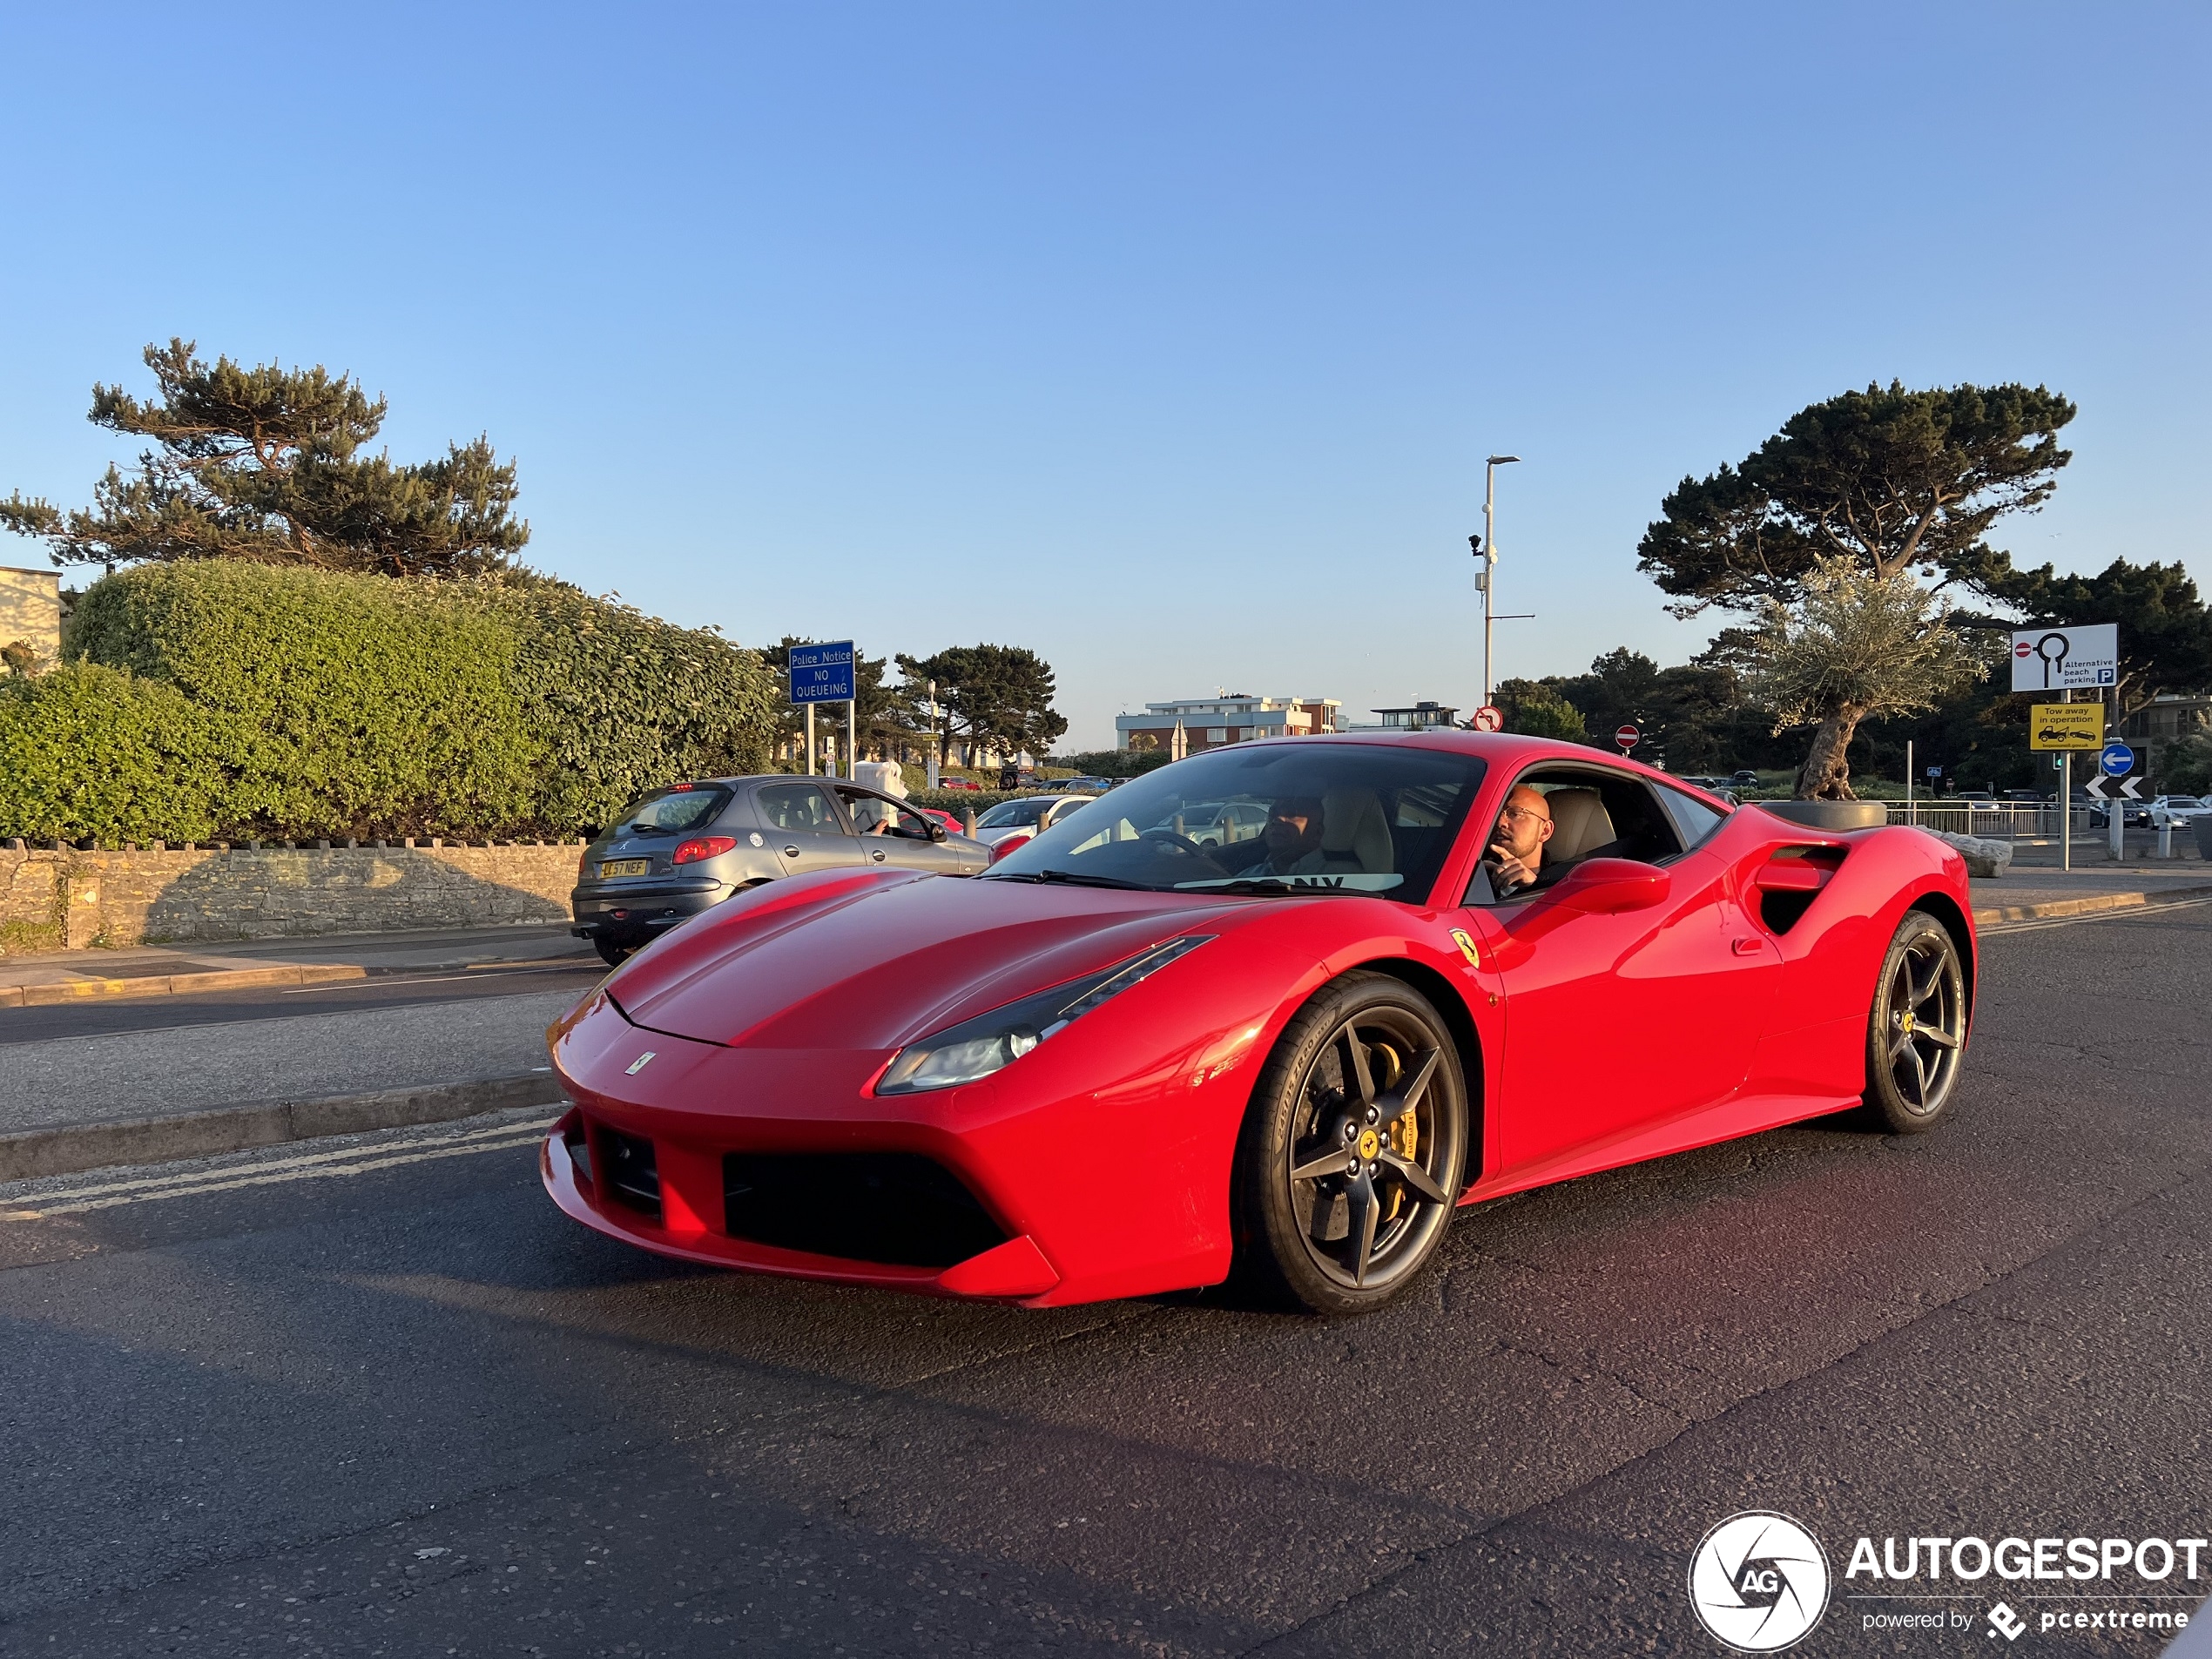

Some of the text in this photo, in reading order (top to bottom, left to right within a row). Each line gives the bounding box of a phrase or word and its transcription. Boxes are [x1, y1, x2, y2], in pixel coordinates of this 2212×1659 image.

[792, 651, 851, 665] Police Notice
[2065, 659, 2114, 668] Alternative
[814, 670, 829, 681] NO
[2064, 677, 2096, 685] parking
[2101, 670, 2112, 683] P
[797, 683, 847, 698] QUEUEING
[2050, 716, 2094, 725] operation
[604, 861, 643, 875] LC57 NEF
[1293, 1039, 1314, 1079] ZR20
